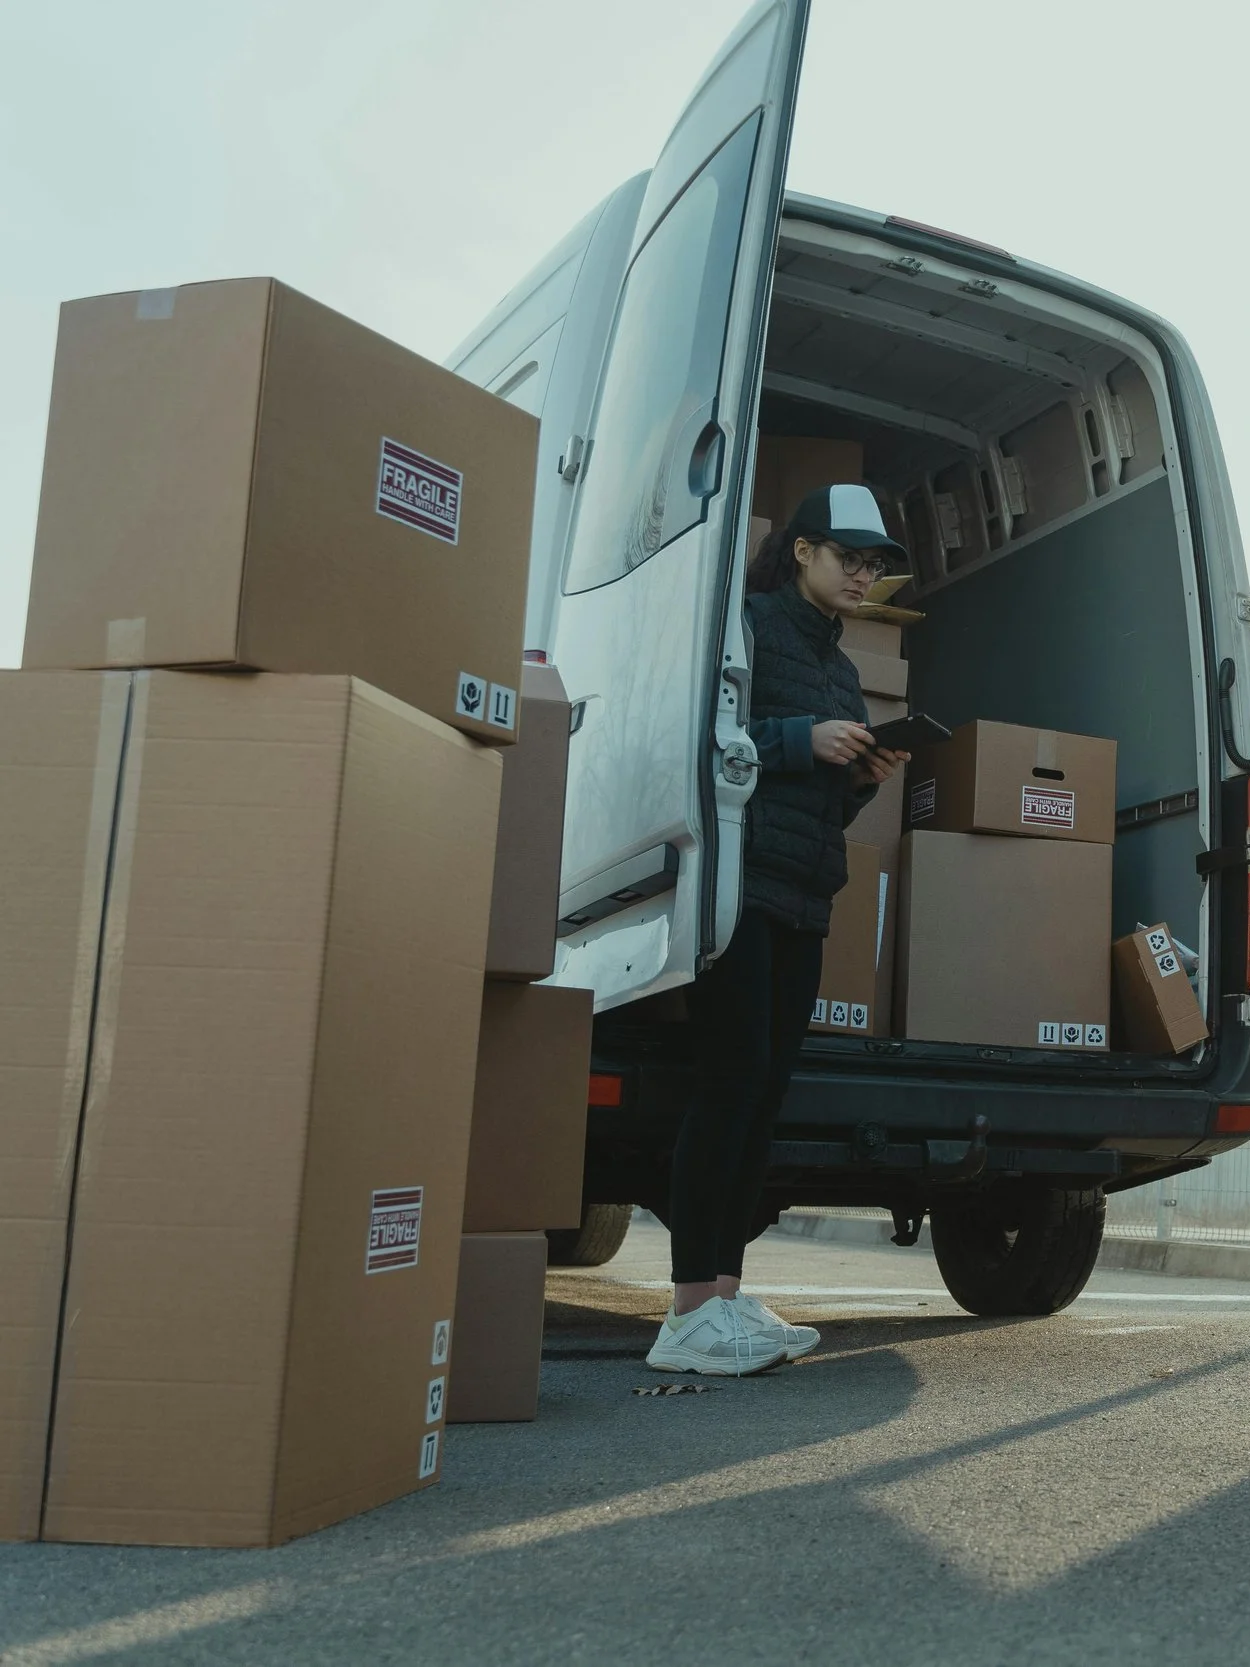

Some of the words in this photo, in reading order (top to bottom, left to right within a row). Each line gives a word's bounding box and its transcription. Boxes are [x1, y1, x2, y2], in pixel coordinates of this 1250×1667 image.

[382, 483, 414, 504] HANDLE
[415, 497, 434, 513] WITH
[435, 506, 456, 522] CARE
[383, 462, 457, 513] FRAGILE
[1024, 802, 1072, 817] FRAGILE
[371, 1220, 419, 1248] FRAGILE
